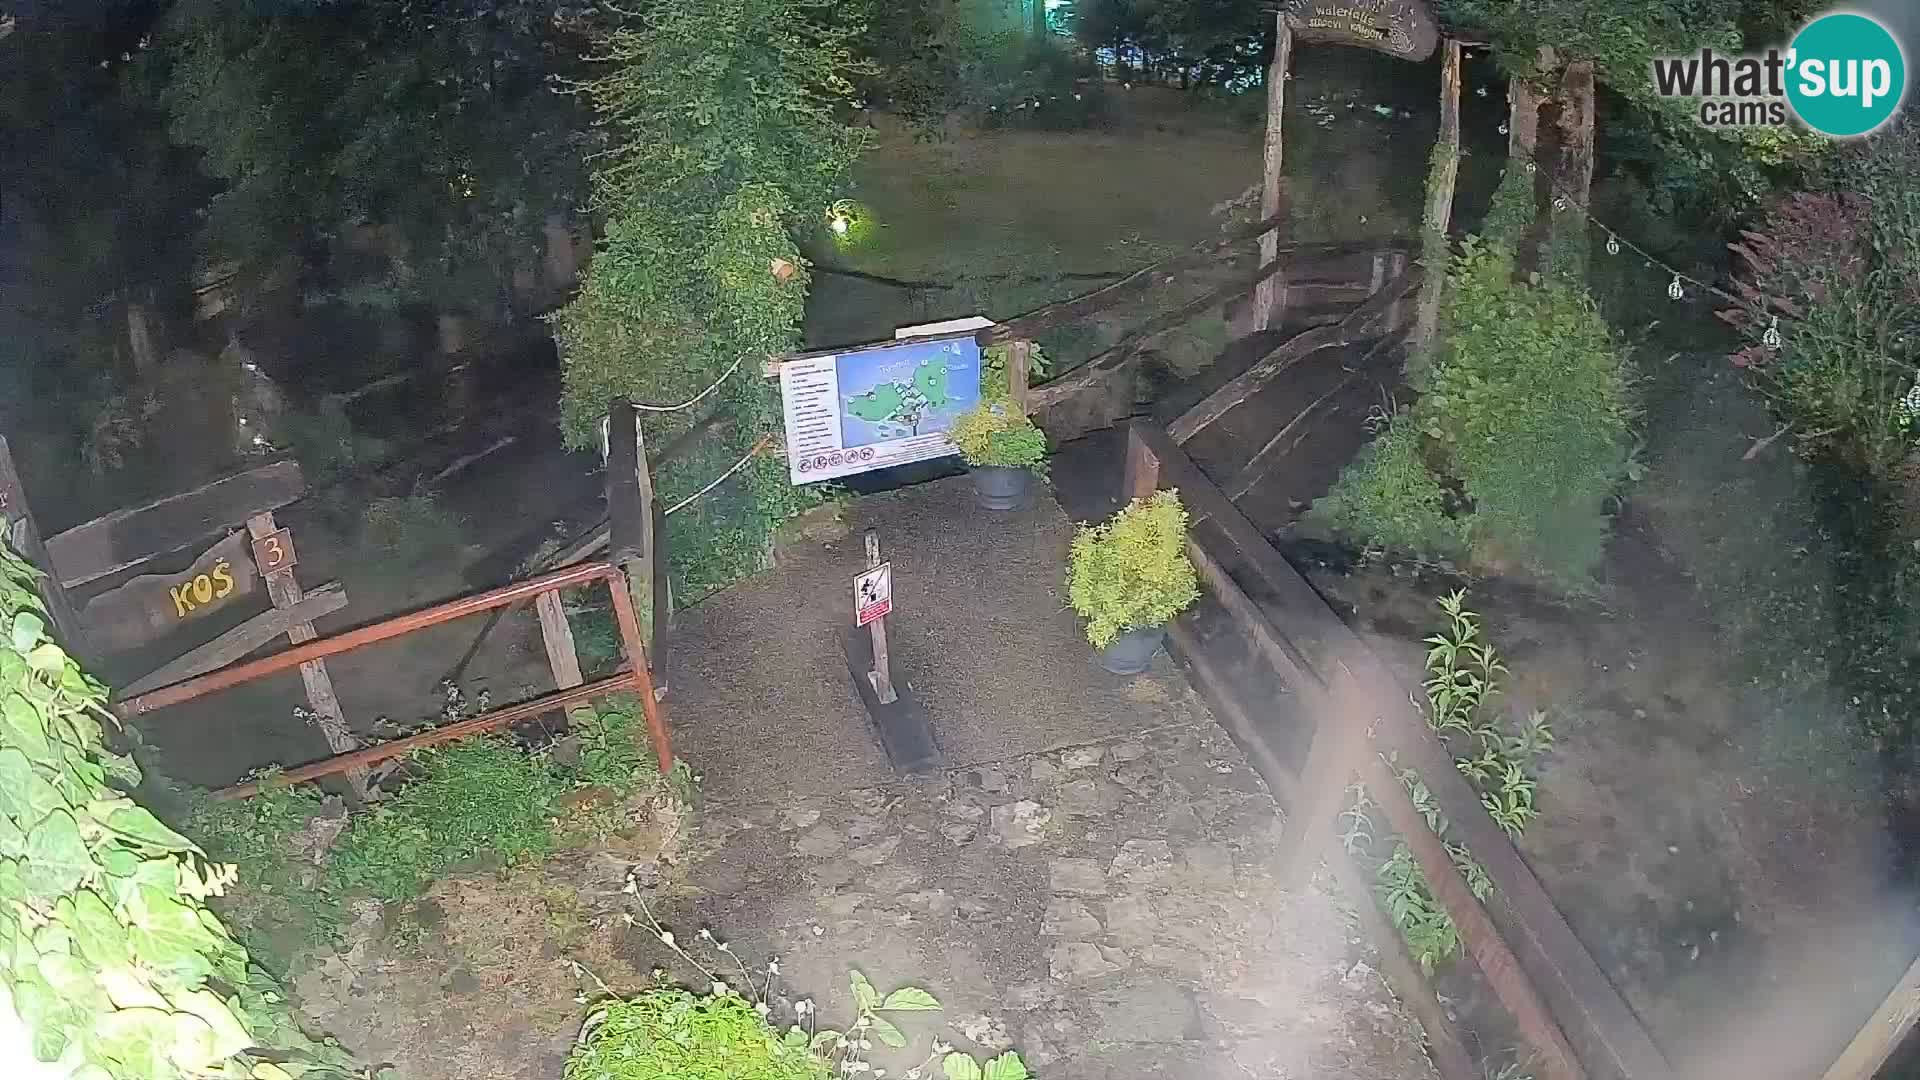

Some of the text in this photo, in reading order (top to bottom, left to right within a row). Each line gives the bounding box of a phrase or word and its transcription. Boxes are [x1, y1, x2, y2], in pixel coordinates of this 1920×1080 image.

[1315, 4, 1375, 26] waterfalls
[263, 537, 283, 566] 3
[169, 556, 234, 617] KOŠ
